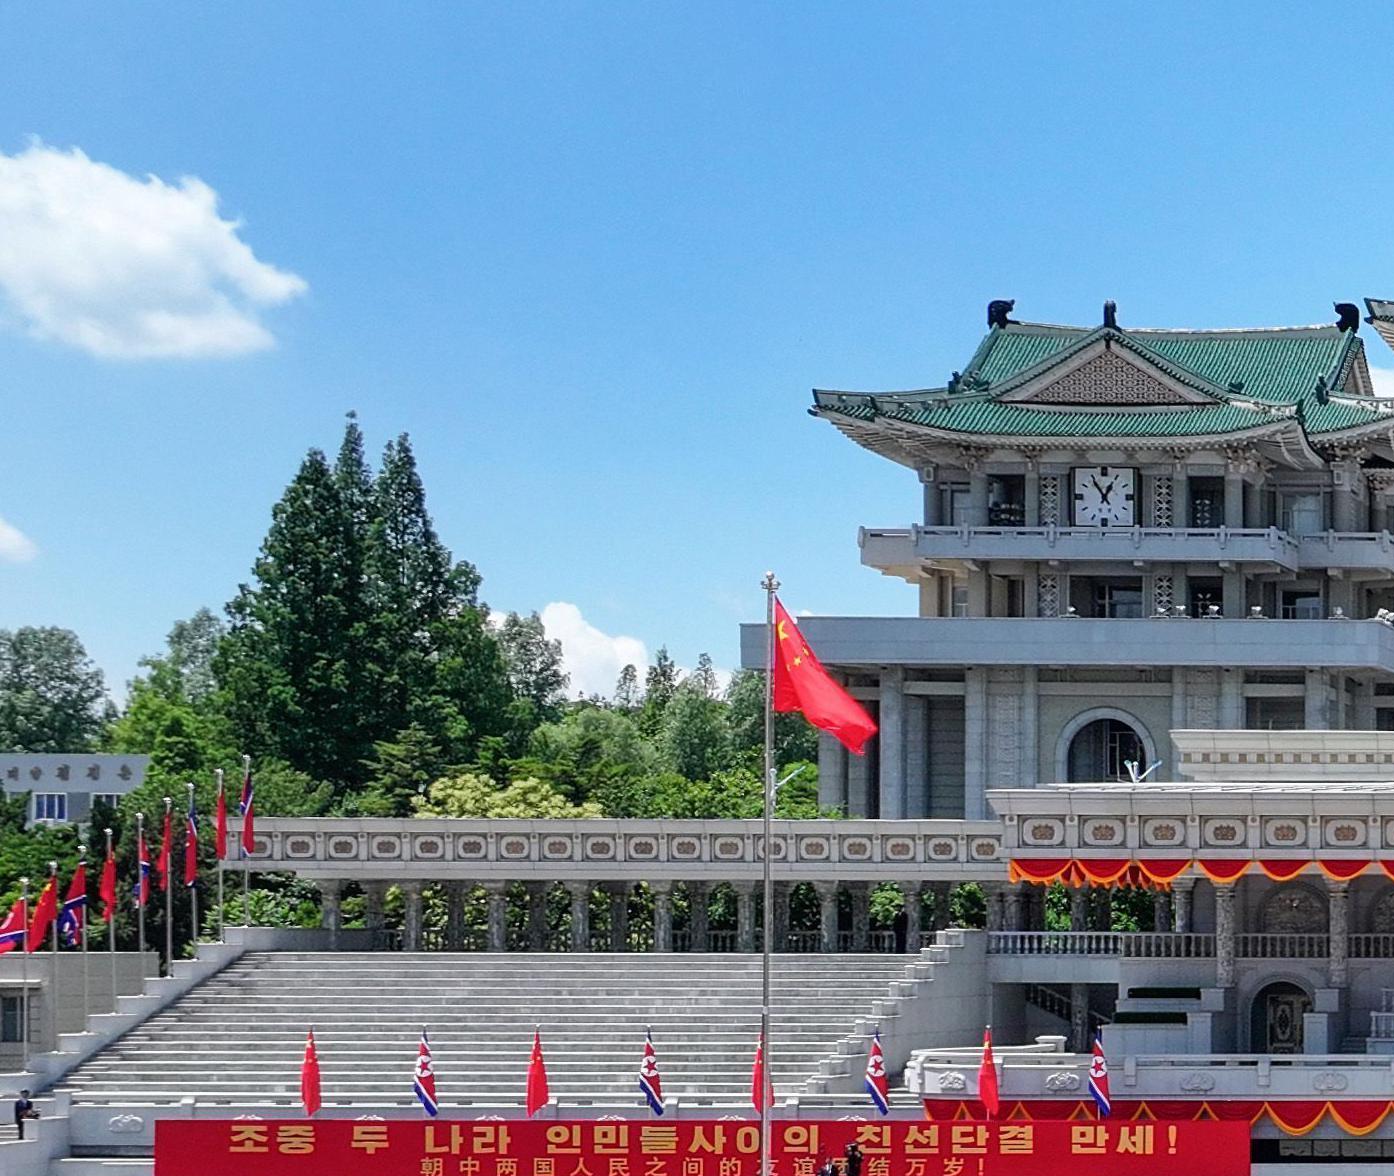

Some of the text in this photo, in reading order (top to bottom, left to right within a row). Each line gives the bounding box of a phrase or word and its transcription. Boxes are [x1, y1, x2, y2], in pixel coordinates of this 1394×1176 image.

[229, 1125, 315, 1154] 조중
[351, 1125, 389, 1155] 두
[425, 1125, 511, 1155] 나라
[855, 1125, 1034, 1155] 친선단결
[1071, 1125, 1177, 1155] 만세!
